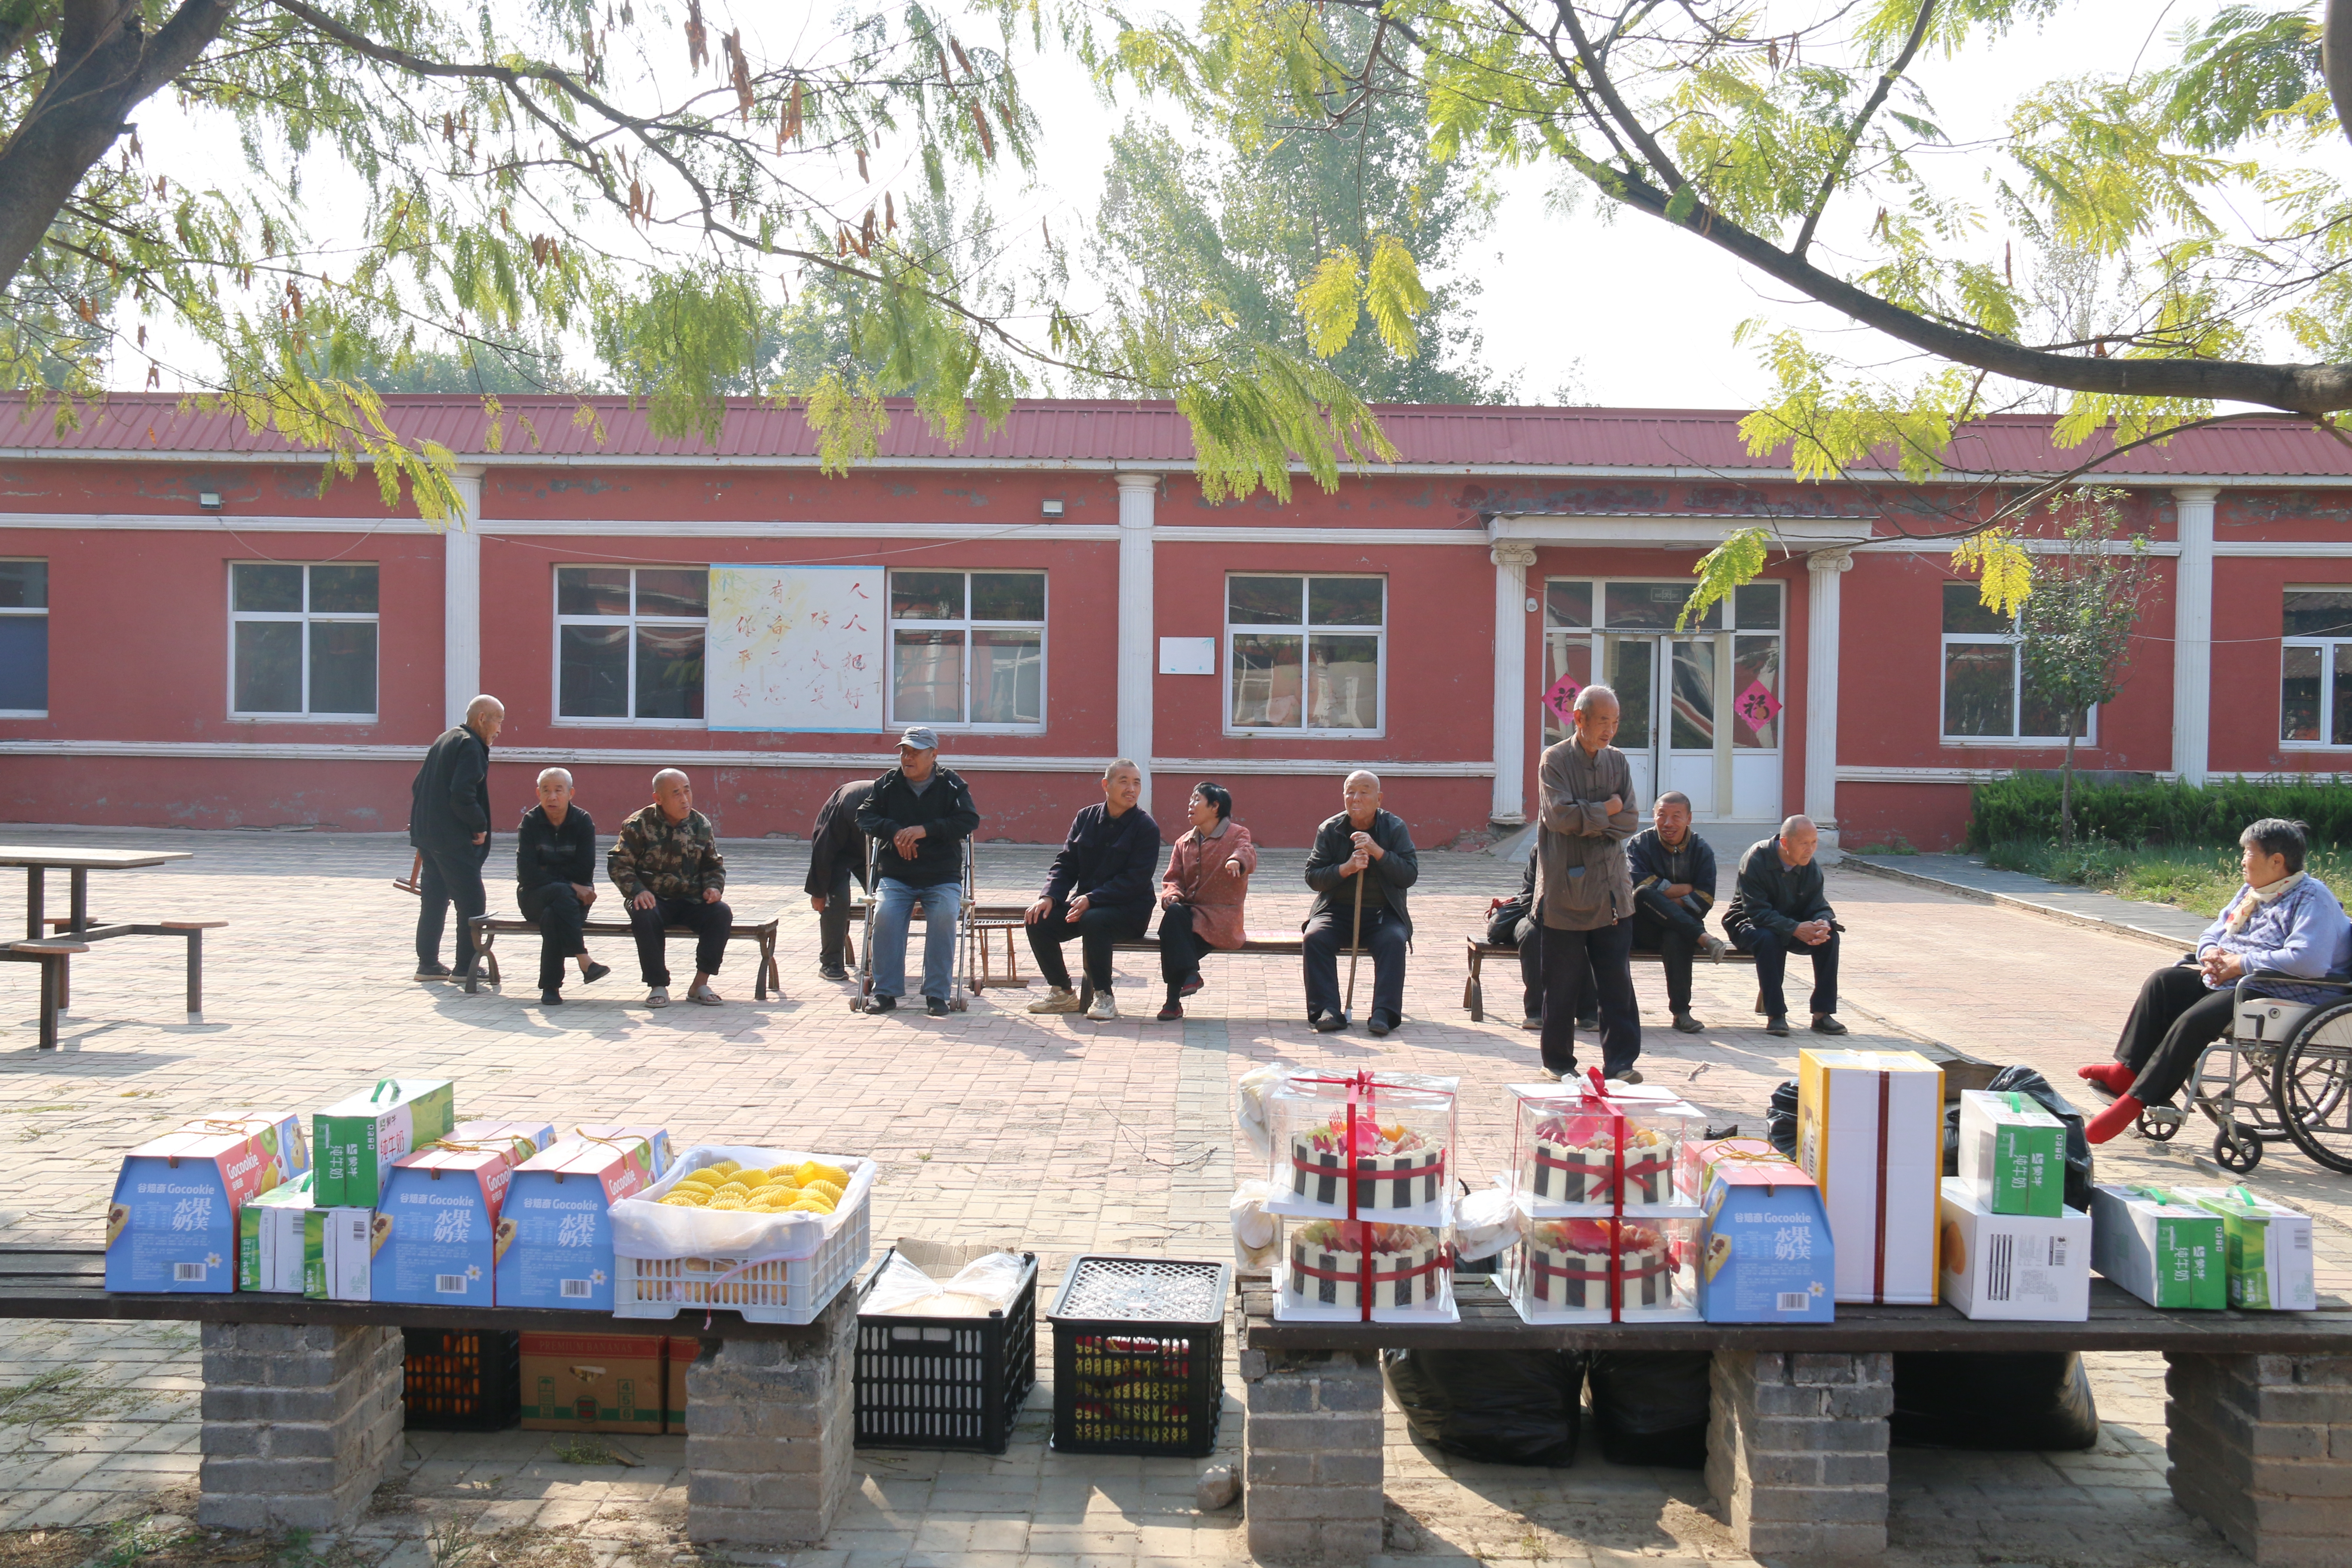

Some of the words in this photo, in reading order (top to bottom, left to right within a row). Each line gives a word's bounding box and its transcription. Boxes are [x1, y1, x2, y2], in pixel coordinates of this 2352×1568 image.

[1743, 694, 1770, 720] 福
[381, 1130, 404, 1162] 纯牛奶
[226, 1152, 260, 1179] Gocookie
[330, 1145, 343, 1179] 纯牛奶
[2012, 1155, 2028, 1188] 纯牛奶
[486, 1163, 517, 1191] Gocook
[168, 1183, 215, 1194] Gocookie
[173, 1197, 212, 1216] 水果
[429, 1194, 474, 1206] Gocookie
[553, 1199, 598, 1210] Gocookie
[172, 1213, 209, 1231] 奶芙
[434, 1209, 472, 1228] 水果
[558, 1213, 596, 1232] 水果
[1764, 1213, 1811, 1223] Gocookie
[433, 1225, 469, 1243] 奶芙
[557, 1229, 594, 1247] 奶芙
[1774, 1225, 1812, 1246] 水果
[1774, 1242, 1811, 1261] 奶芙
[2174, 1247, 2189, 1281] 纯牛奶
[540, 1341, 584, 1351] PREMIUM
[587, 1341, 632, 1353] BANANAS
[622, 1382, 630, 1391] 4
[622, 1395, 631, 1405] 5
[623, 1409, 631, 1418] 6
